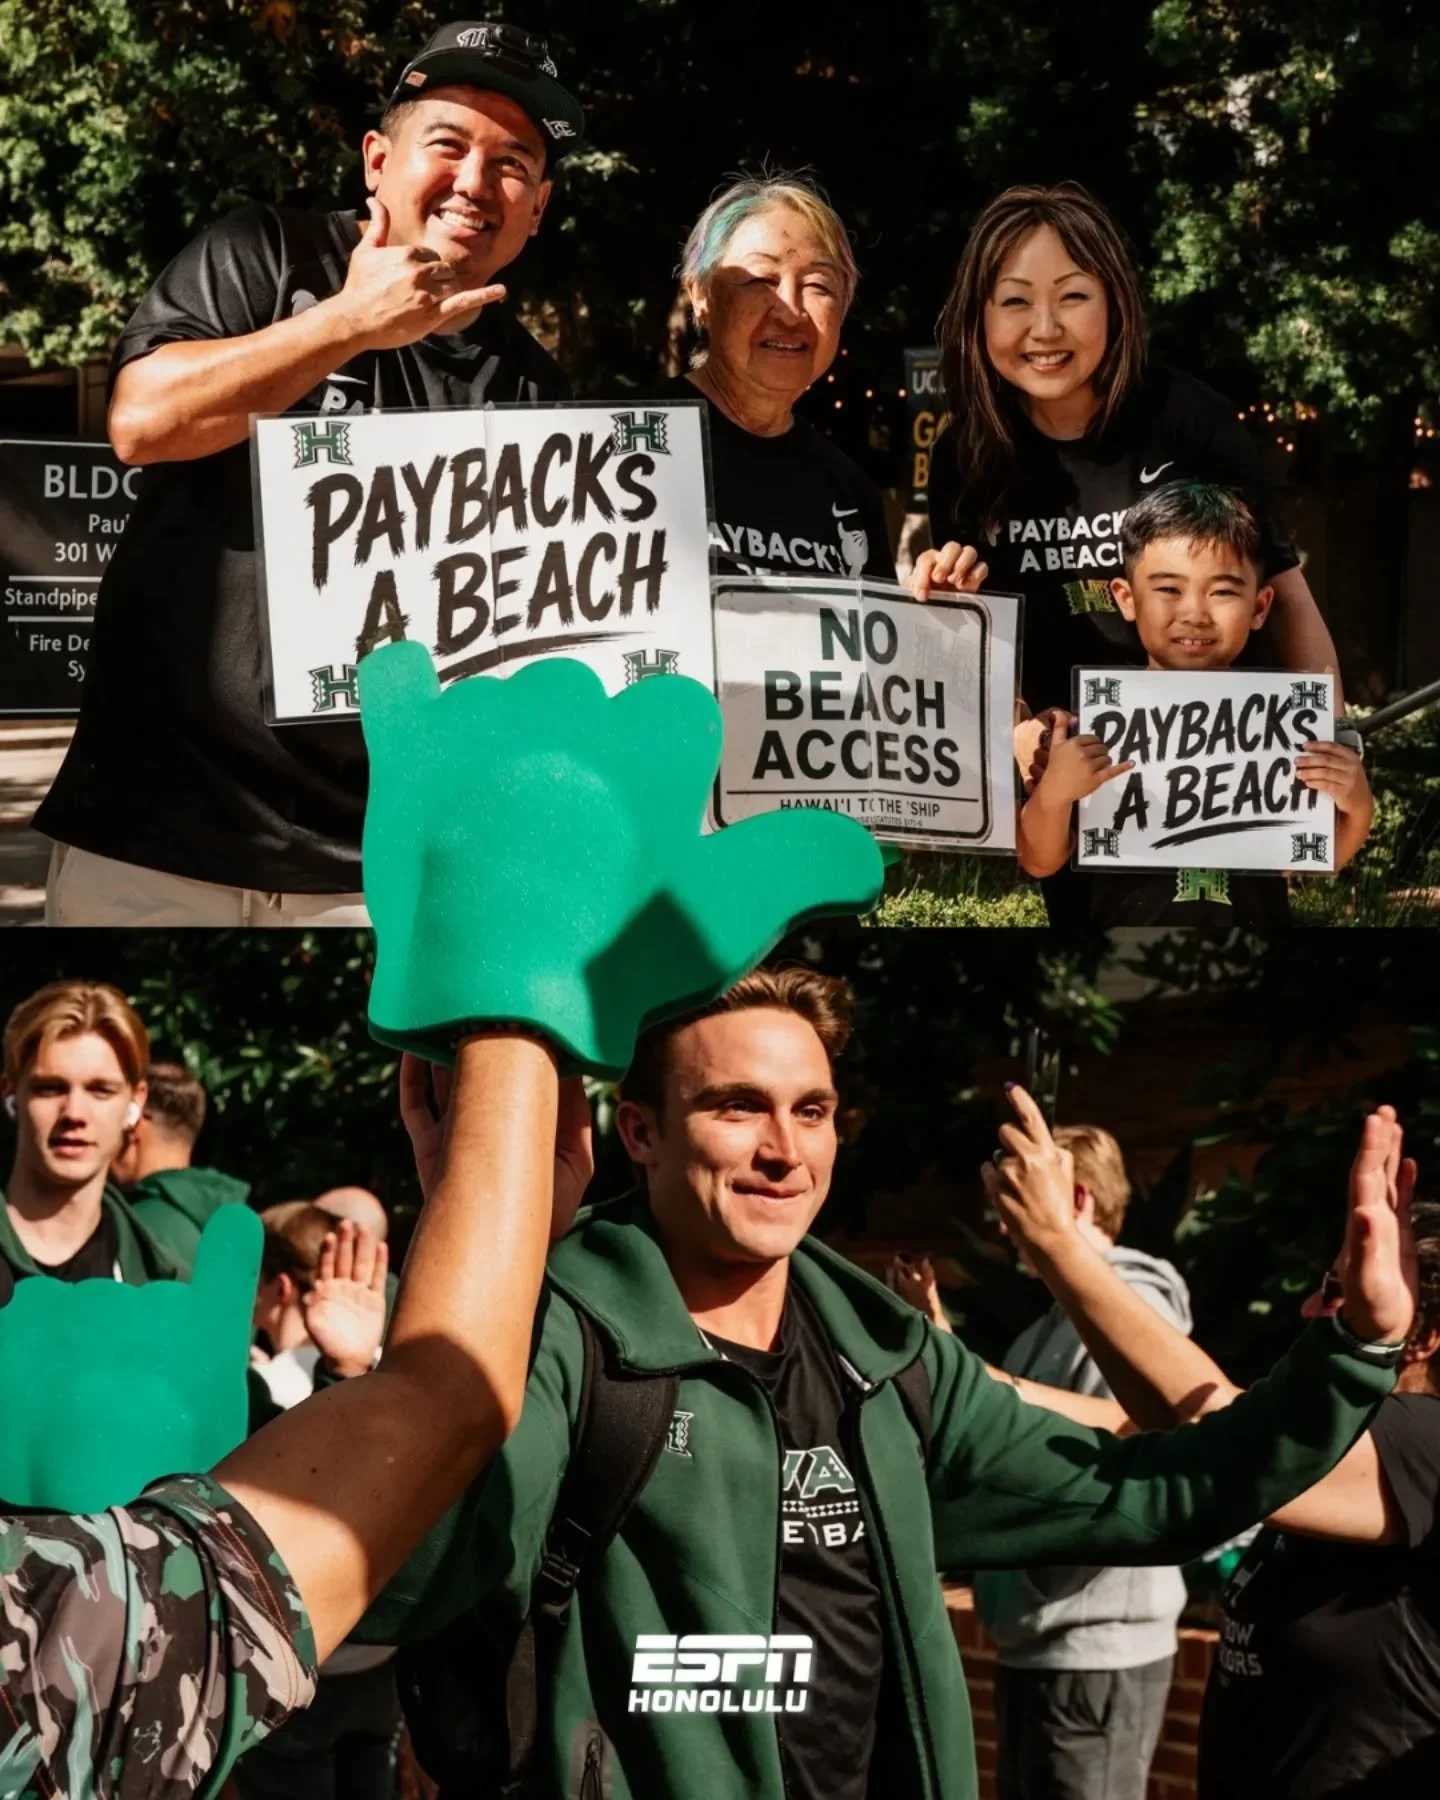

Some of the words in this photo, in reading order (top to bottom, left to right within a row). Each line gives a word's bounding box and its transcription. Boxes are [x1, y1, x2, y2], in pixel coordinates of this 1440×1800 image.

[912, 370, 946, 394] UC
[88, 513, 130, 534] Pau
[304, 432, 658, 593] PAYBACKS
[54, 542, 88, 562] 301
[1019, 548, 1042, 574] A
[4, 588, 98, 611] Standpipe
[355, 570, 411, 665] A
[431, 528, 668, 656] BEACH
[29, 634, 62, 652] Fire
[819, 607, 898, 665] NO
[763, 670, 946, 729] BEACH
[1089, 692, 1319, 765] PAYBACKS
[752, 728, 961, 787] ACCESS
[878, 798, 902, 814] THE
[1112, 771, 1149, 832] A
